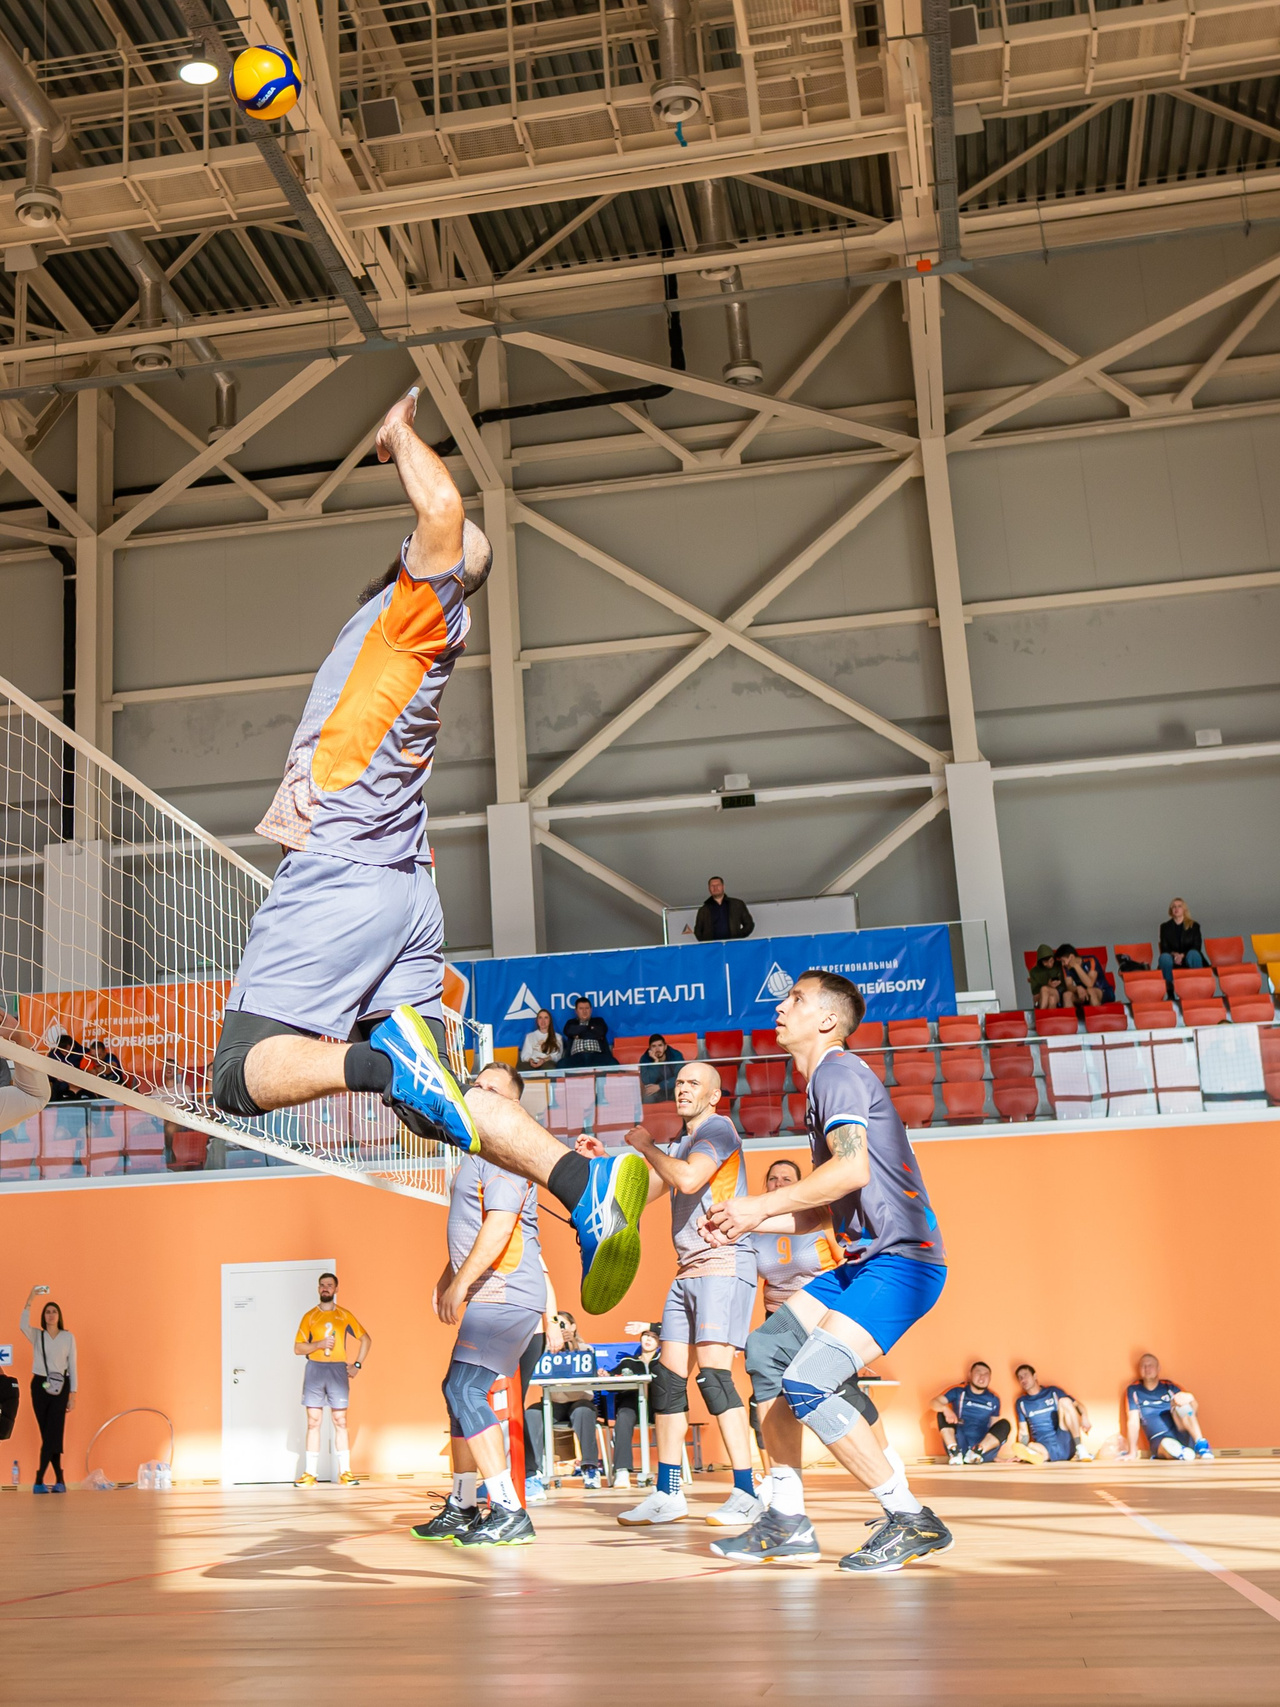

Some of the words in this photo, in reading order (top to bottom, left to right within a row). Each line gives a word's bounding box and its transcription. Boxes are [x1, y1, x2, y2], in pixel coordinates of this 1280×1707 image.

[550, 983, 705, 1010] ПОЛИМЕТАЛЛ
[857, 978, 926, 995] ЛЕЙБОЛУ
[103, 1033, 182, 1048] ВОЛЕЙБОЛУ
[777, 1236, 792, 1265] 9
[564, 1354, 571, 1365] 1
[572, 1353, 592, 1373] 18
